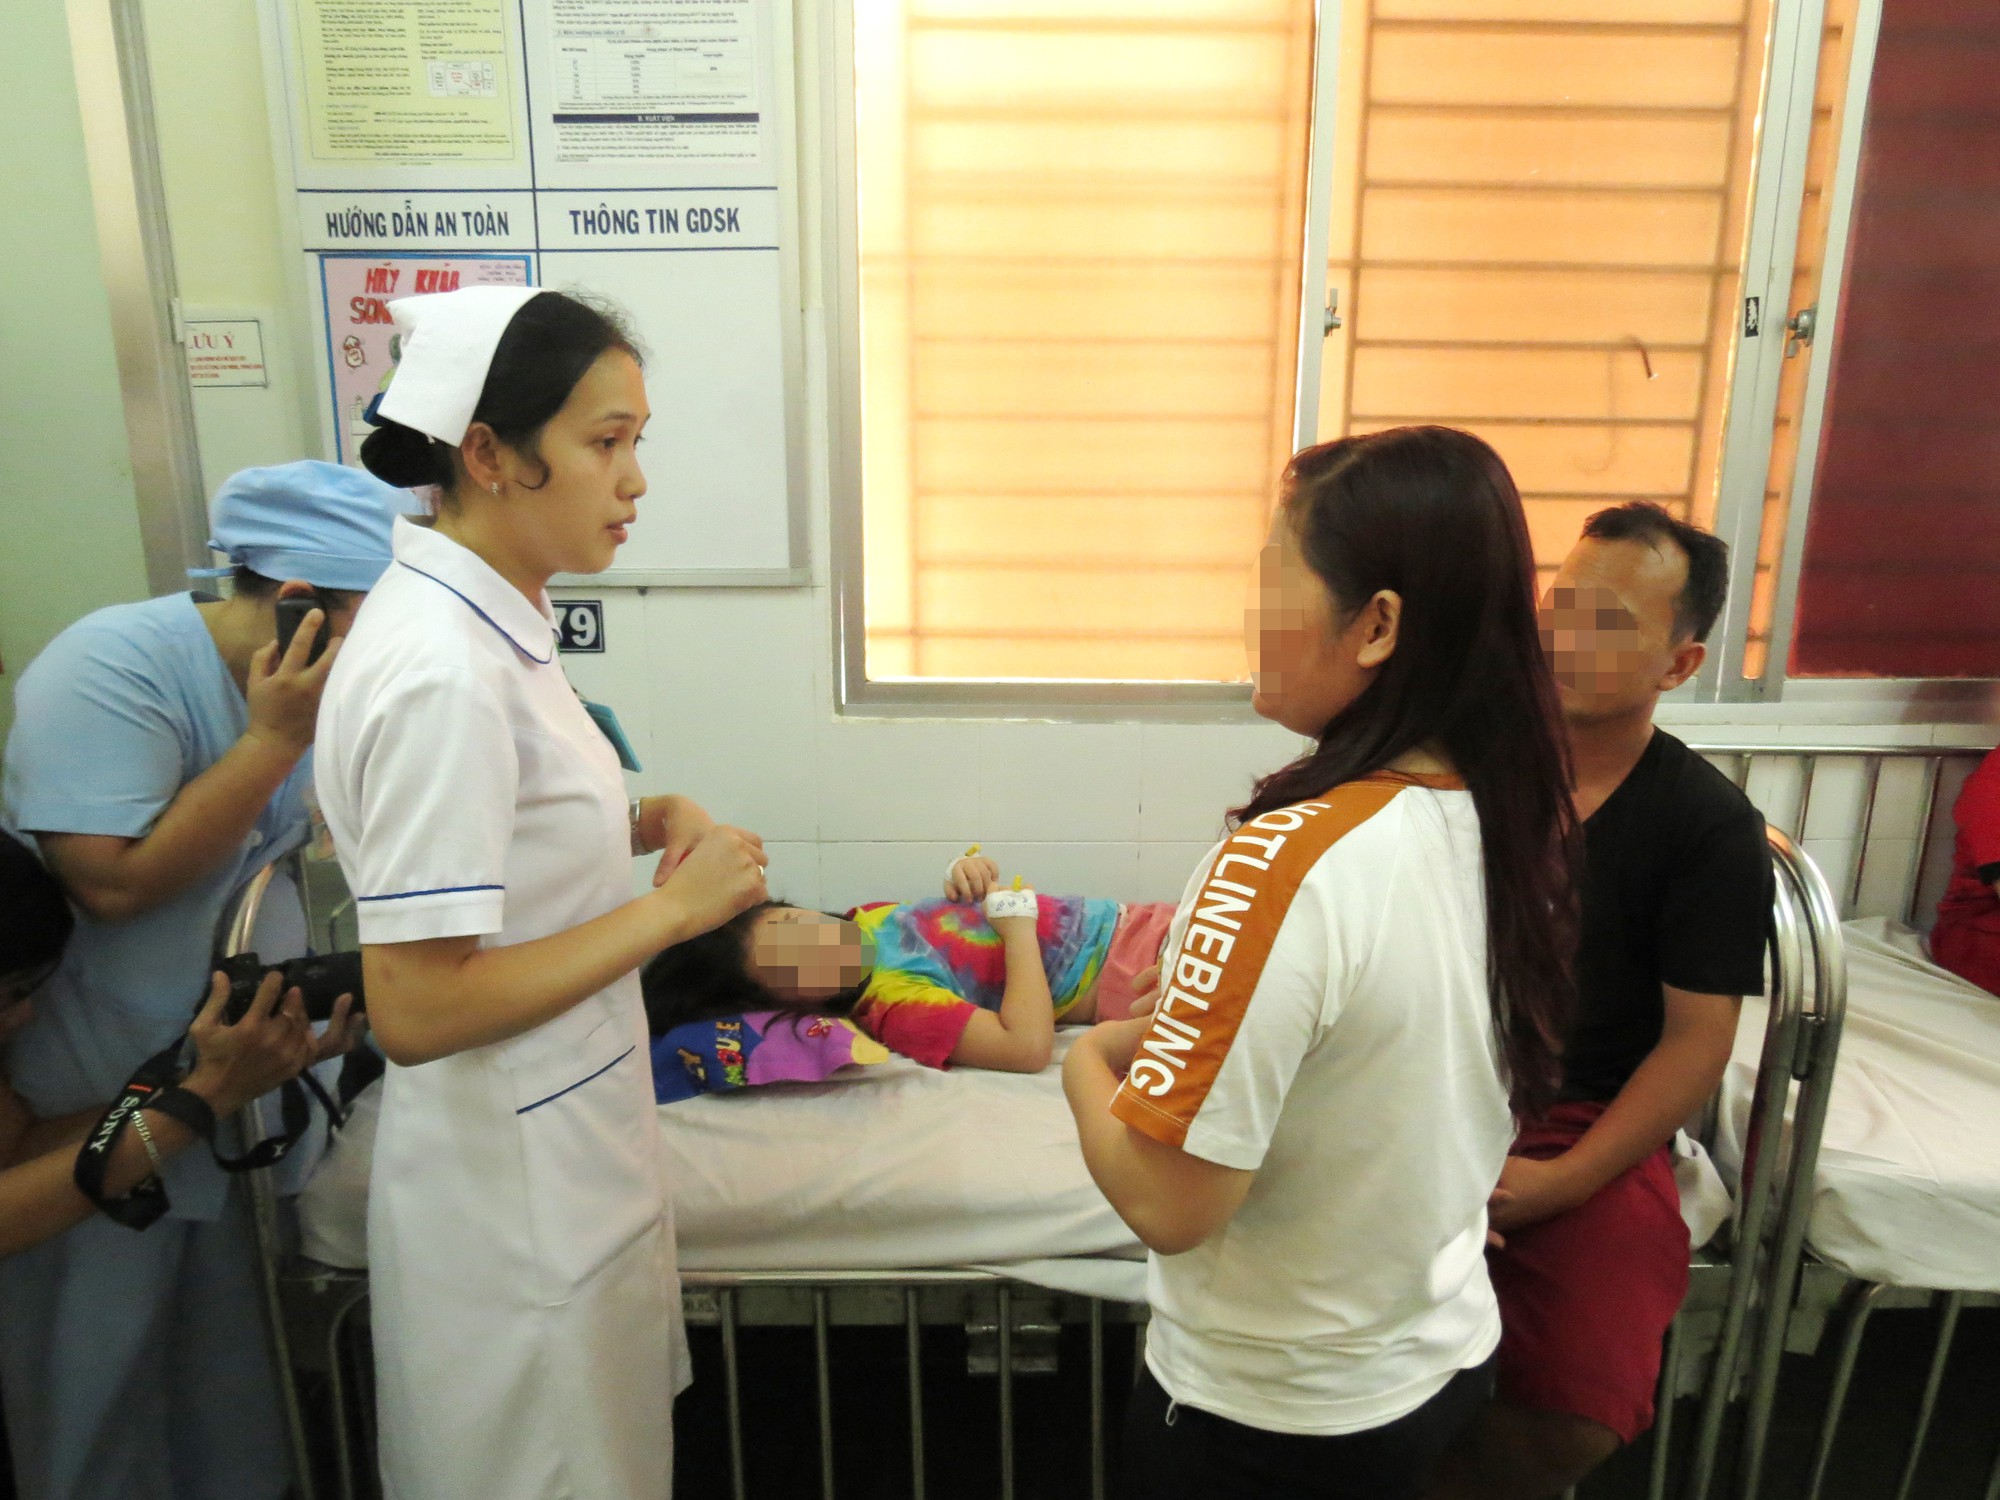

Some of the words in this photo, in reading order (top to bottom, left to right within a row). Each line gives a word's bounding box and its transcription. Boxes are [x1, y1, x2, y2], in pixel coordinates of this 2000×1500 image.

[326, 205, 387, 237] HƯỚNG
[393, 199, 429, 237] DẪN
[435, 211, 457, 236] AN
[462, 204, 510, 236] TOÀN
[568, 202, 640, 235] THÔNG
[645, 208, 679, 233] TIN
[686, 207, 740, 233] GDSK
[188, 332, 218, 349] ƯU
[89, 1095, 140, 1153] SONY
